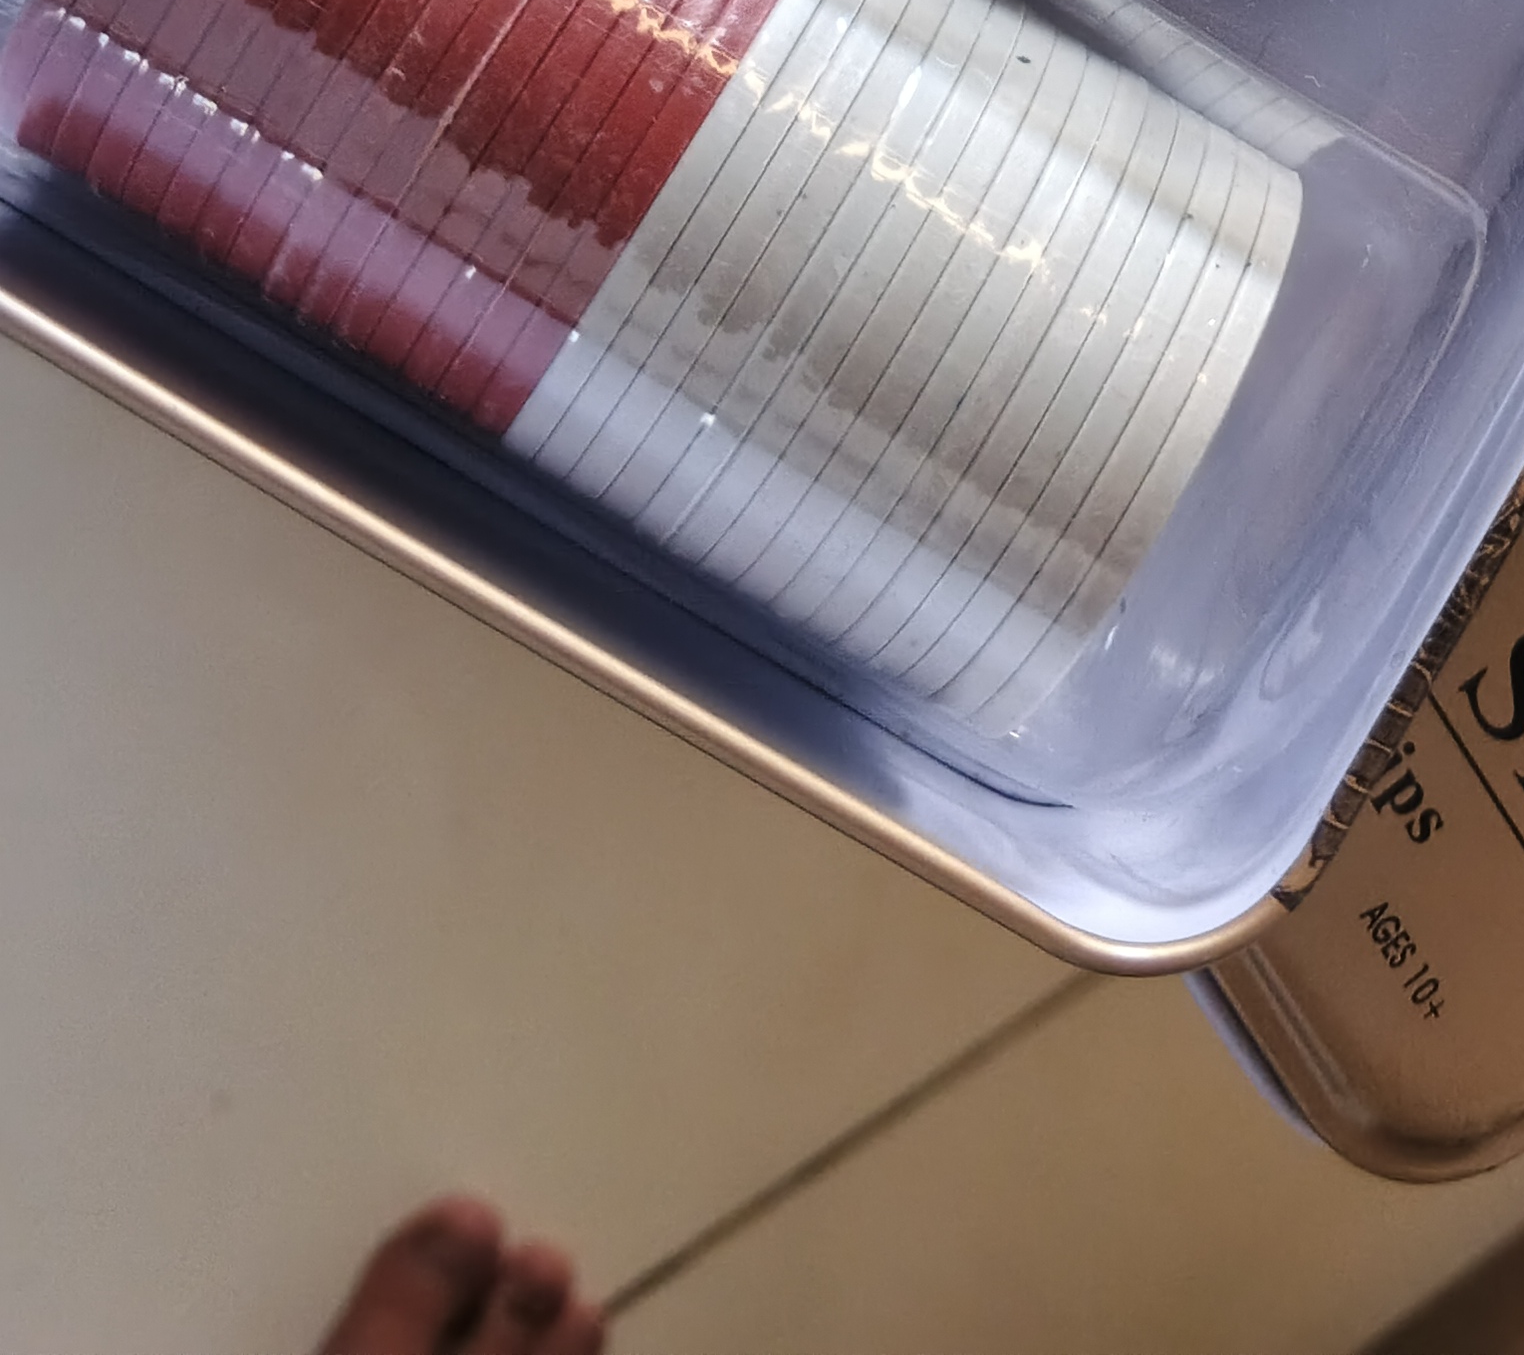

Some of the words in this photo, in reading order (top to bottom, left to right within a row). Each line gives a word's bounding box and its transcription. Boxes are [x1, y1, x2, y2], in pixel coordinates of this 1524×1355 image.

[1370, 740, 1445, 844] ips
[1359, 901, 1418, 969] AGES
[1403, 962, 1446, 1020] 10+
